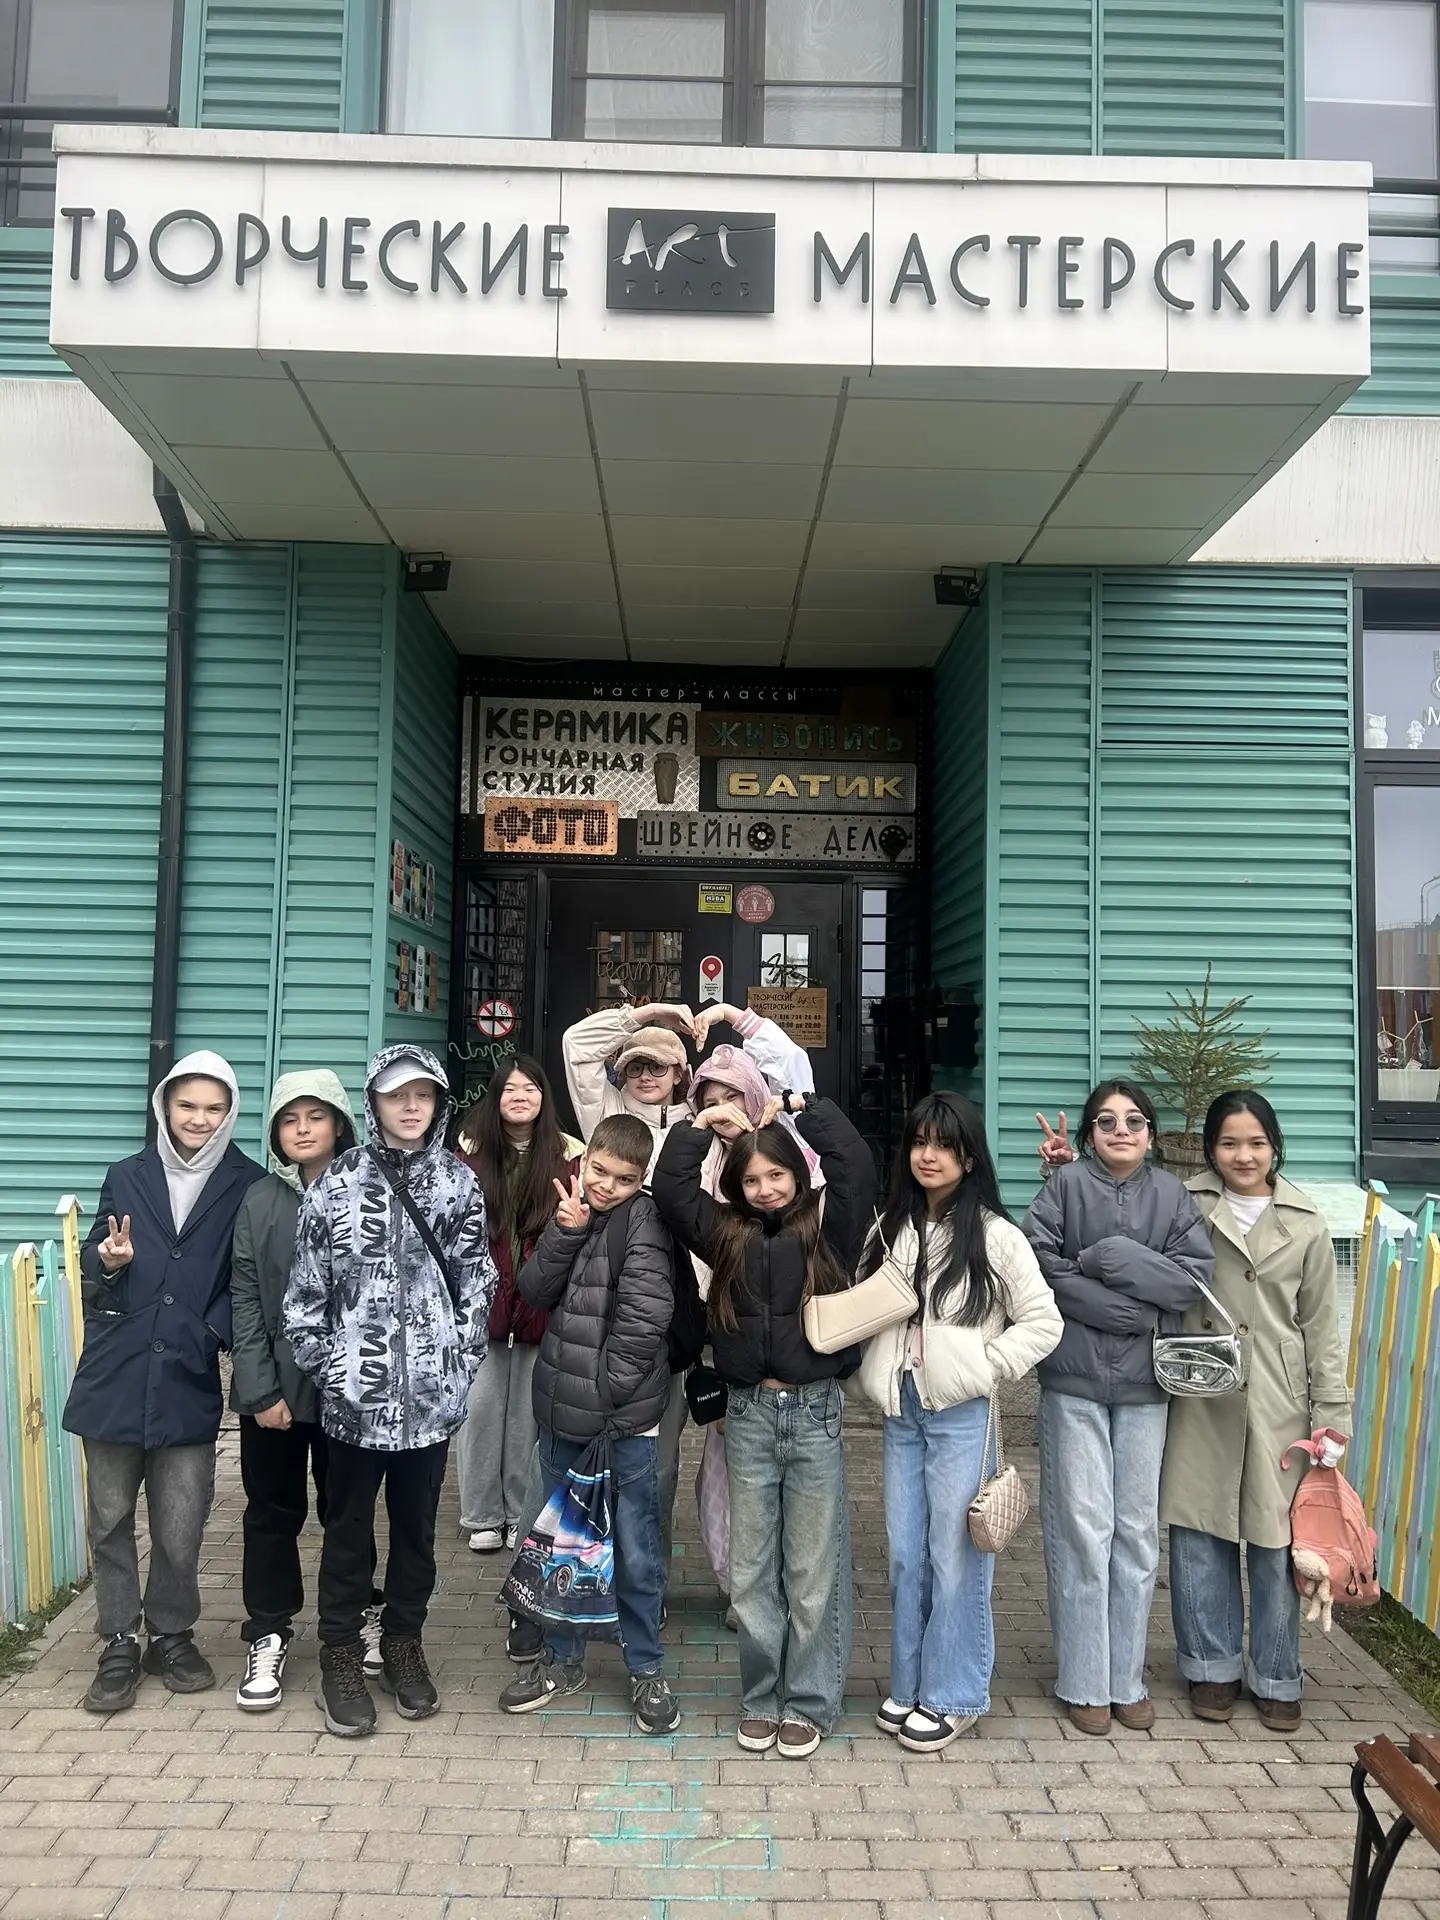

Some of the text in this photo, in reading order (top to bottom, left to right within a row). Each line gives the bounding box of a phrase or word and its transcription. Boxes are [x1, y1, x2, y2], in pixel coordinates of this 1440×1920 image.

[60, 207, 570, 298] ТВОРЧЕСКИЕ
[813, 231, 1365, 316] МАСТЕРСКИЕ
[622, 279, 750, 297] PLACE
[485, 707, 689, 745] КЕРАМИКА
[484, 745, 644, 773] ГОНЧАРНАЯ
[482, 770, 596, 795] СТУДИЯ
[728, 772, 906, 799] БАТИК
[493, 806, 609, 847] ФОТО
[643, 818, 793, 851] ШВЕЙНОЕ
[752, 1003, 793, 1011] МАСТЕРСКИЕ
[753, 993, 793, 1002] ТВОРЧЕСКИЕ
